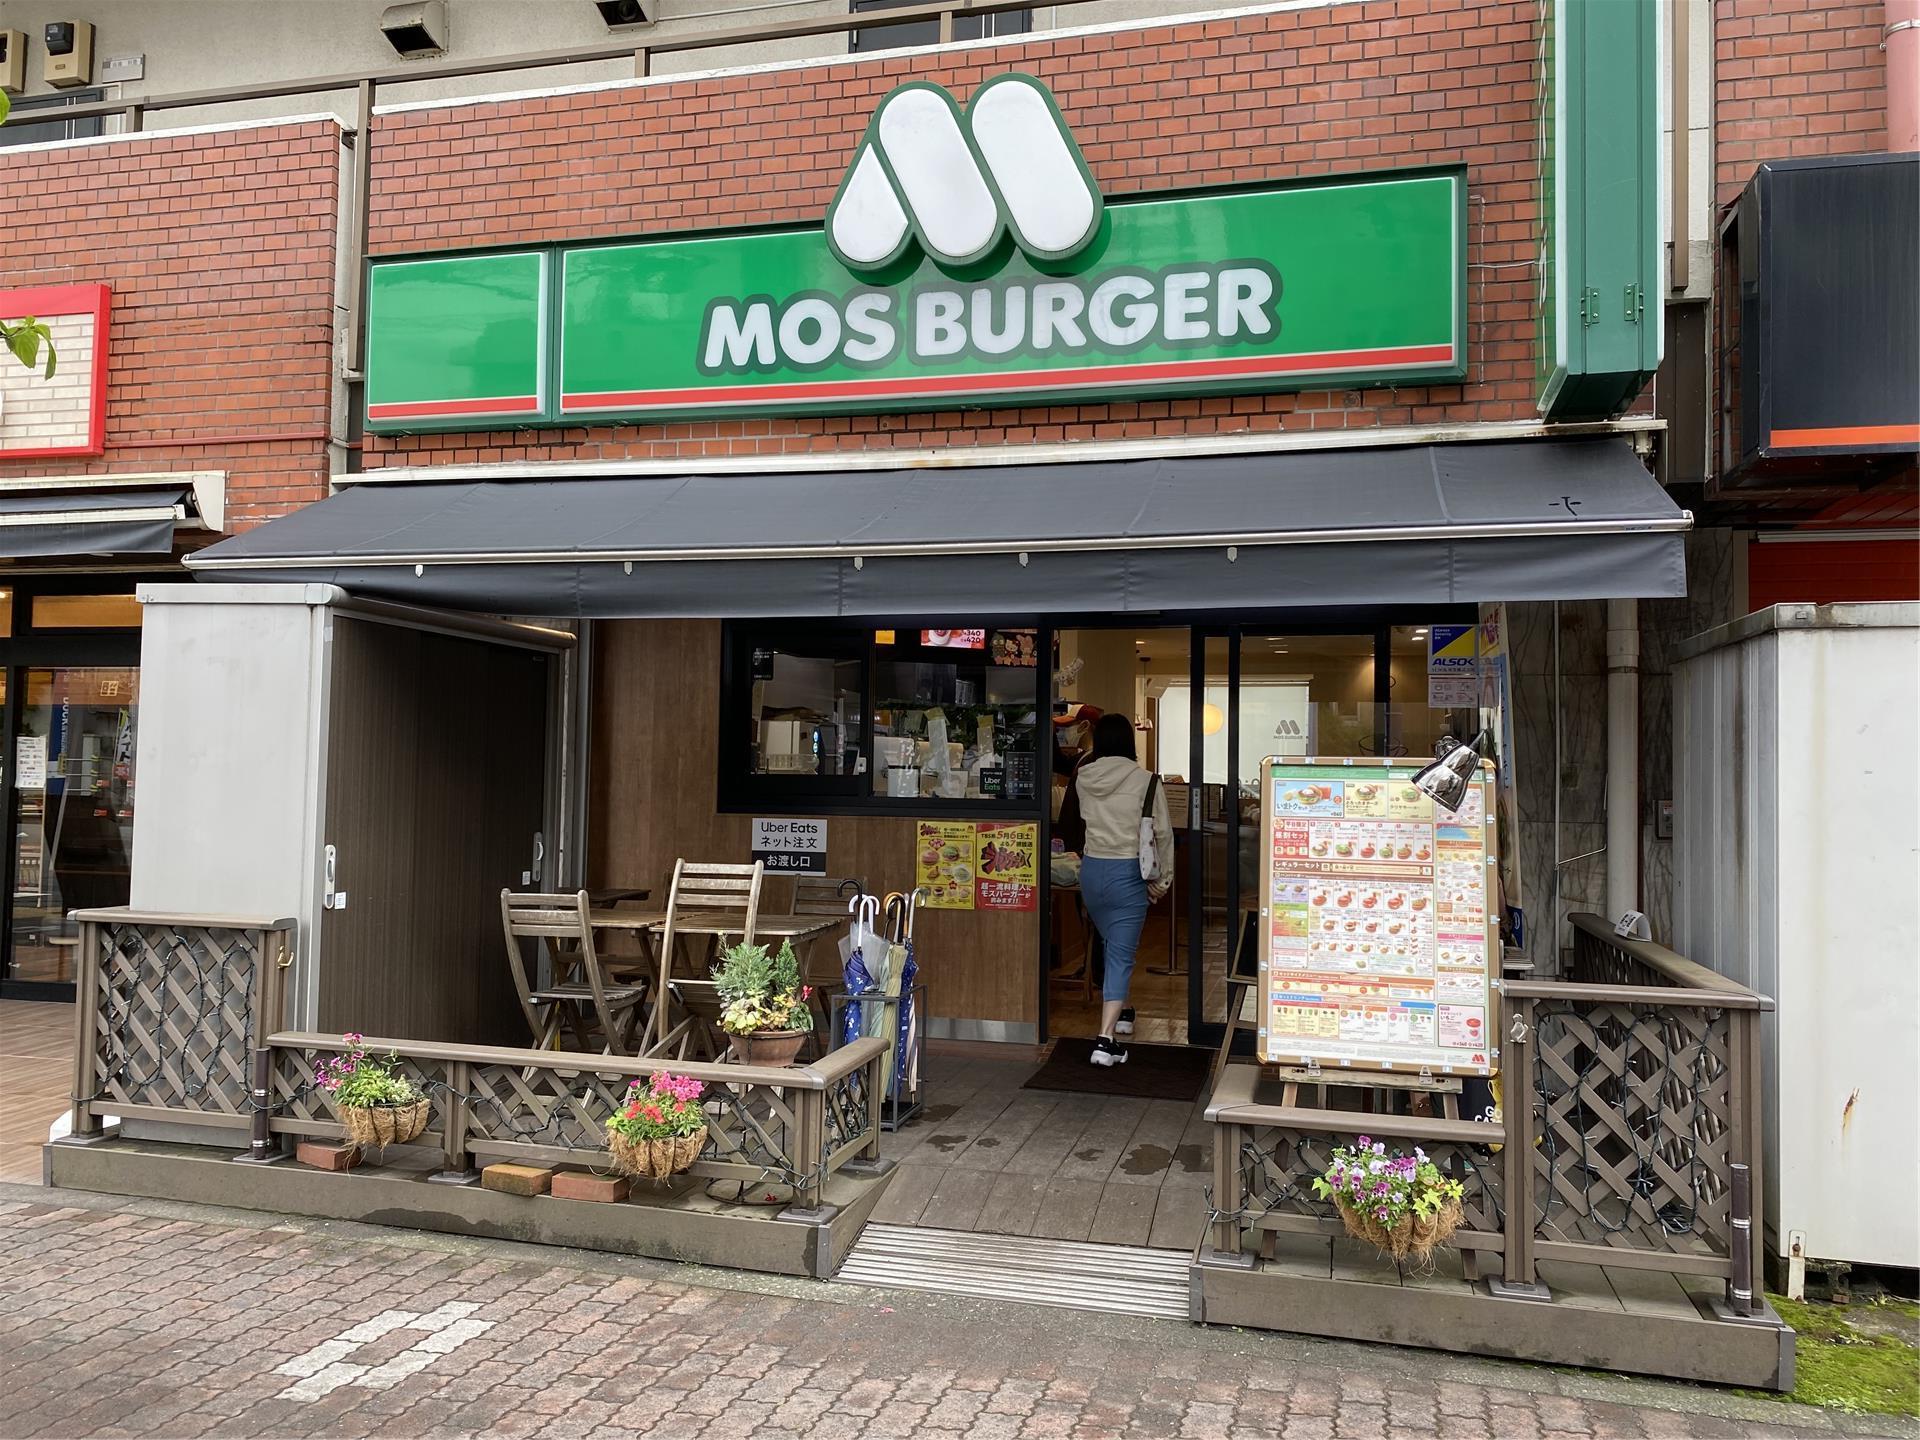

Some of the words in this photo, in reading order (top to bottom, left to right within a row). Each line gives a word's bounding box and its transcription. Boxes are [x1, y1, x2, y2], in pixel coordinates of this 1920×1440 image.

[704, 293, 896, 367] MOS
[915, 268, 1273, 356] BURGER
[1432, 658, 1474, 666] ALSOK
[761, 822, 788, 832] Uber
[791, 823, 818, 833] Eats
[761, 836, 817, 848] ネット注文
[767, 855, 810, 867] お渡し口
[981, 890, 1031, 898] モスバーガーが
